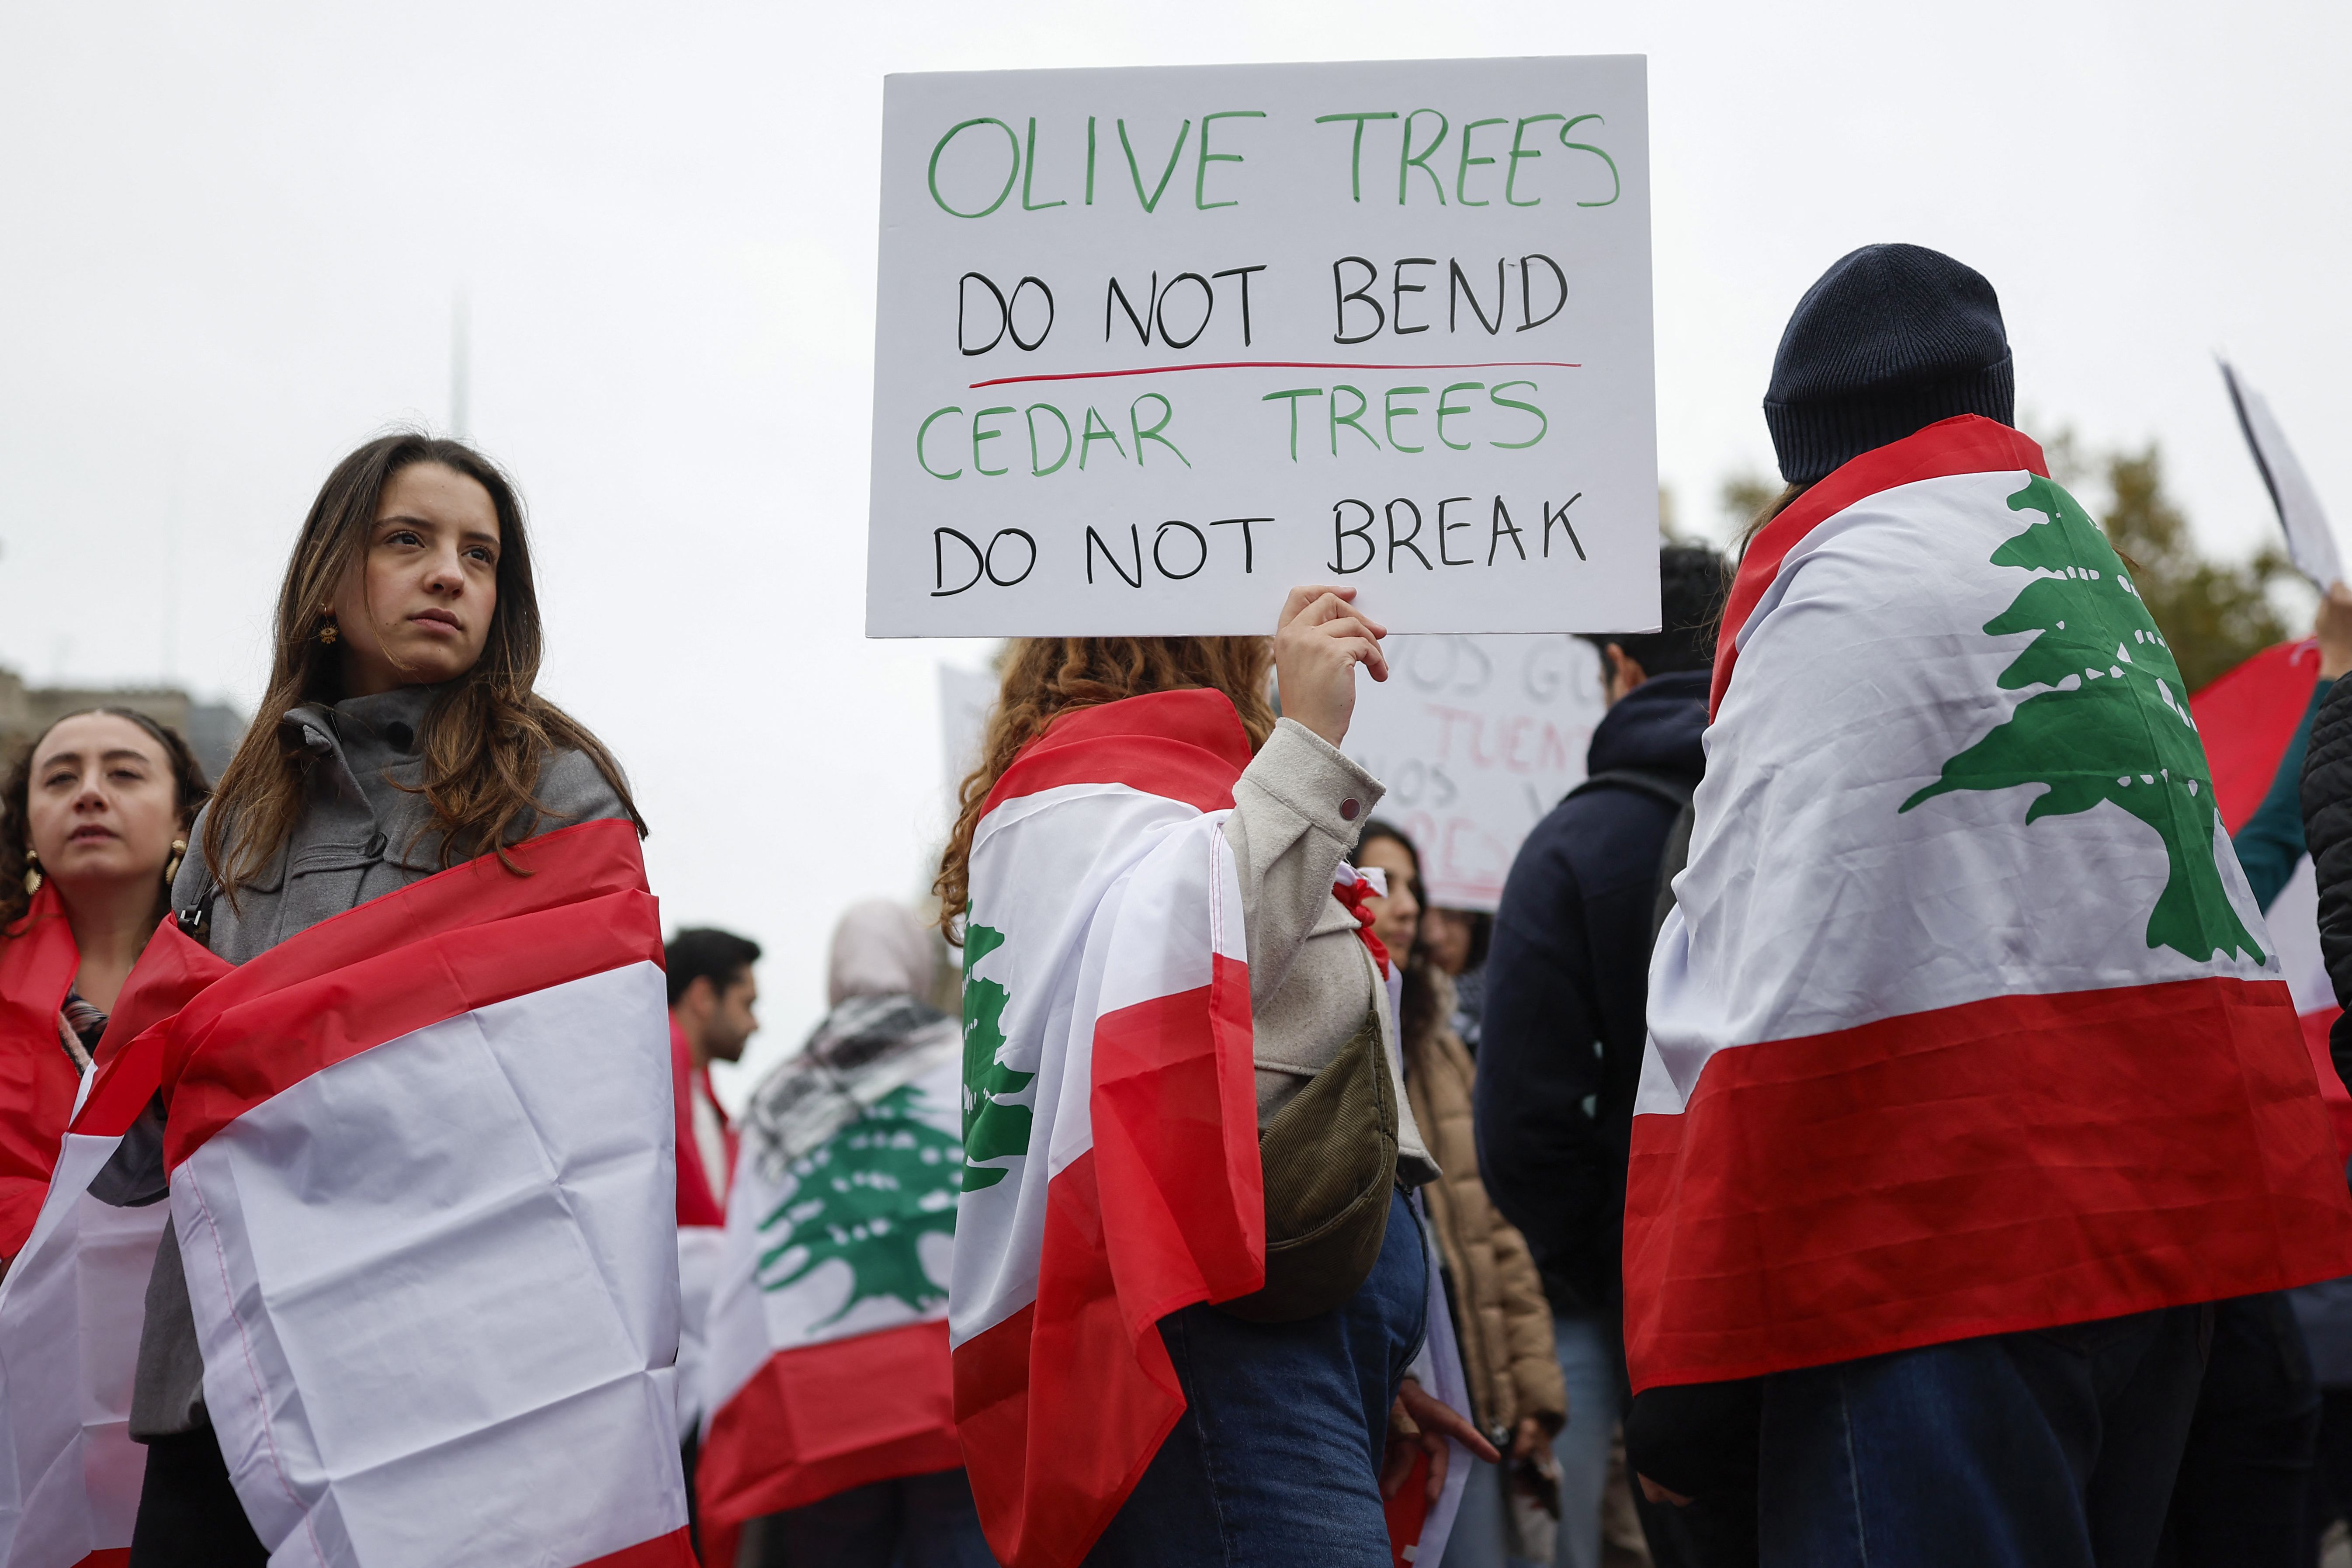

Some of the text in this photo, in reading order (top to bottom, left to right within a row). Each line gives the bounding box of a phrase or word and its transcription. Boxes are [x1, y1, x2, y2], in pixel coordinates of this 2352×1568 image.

[927, 108, 1620, 219] OLIVE TREES
[958, 253, 1568, 356] DO NOT BEND
[916, 380, 1548, 481] CEDAR TREES
[930, 492, 1587, 597] DO NOT BREAK
